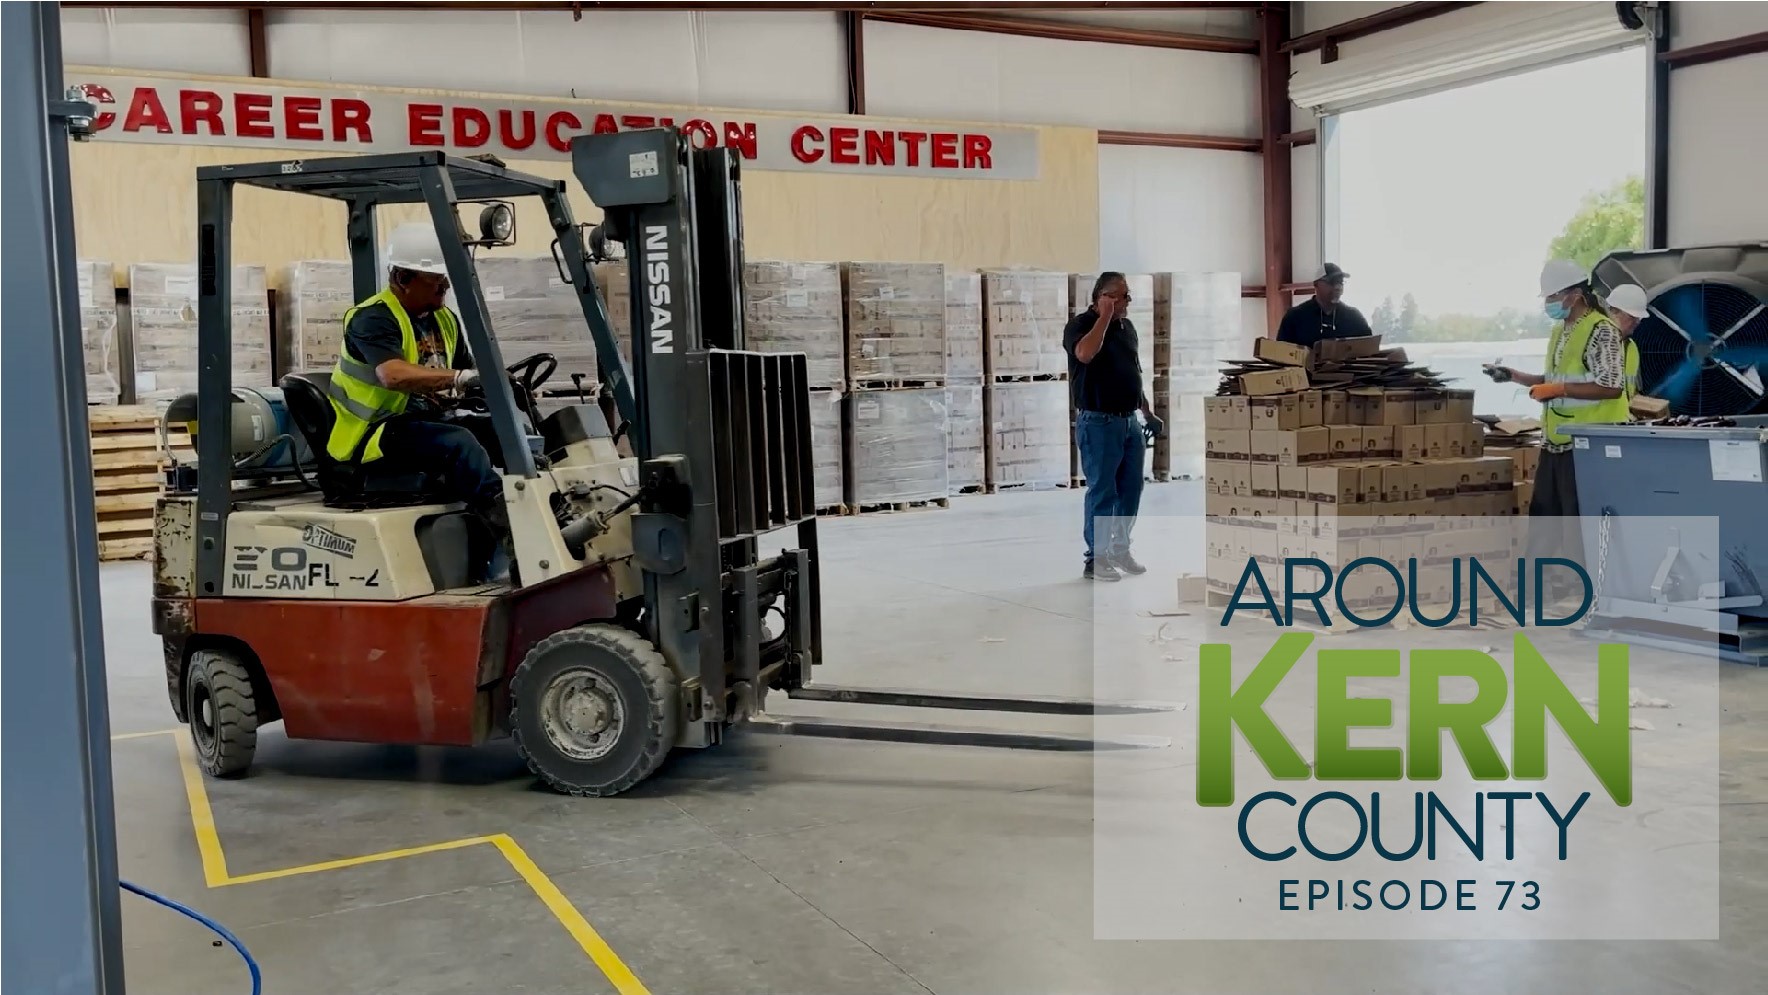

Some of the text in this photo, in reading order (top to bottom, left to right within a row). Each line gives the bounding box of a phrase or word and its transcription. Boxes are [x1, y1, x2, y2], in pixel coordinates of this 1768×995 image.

[80, 83, 374, 143] CAREER
[790, 125, 993, 169] CENTER
[645, 225, 674, 353] NISSAN
[302, 524, 356, 555] OPTIMUM
[231, 573, 306, 590] NISAN
